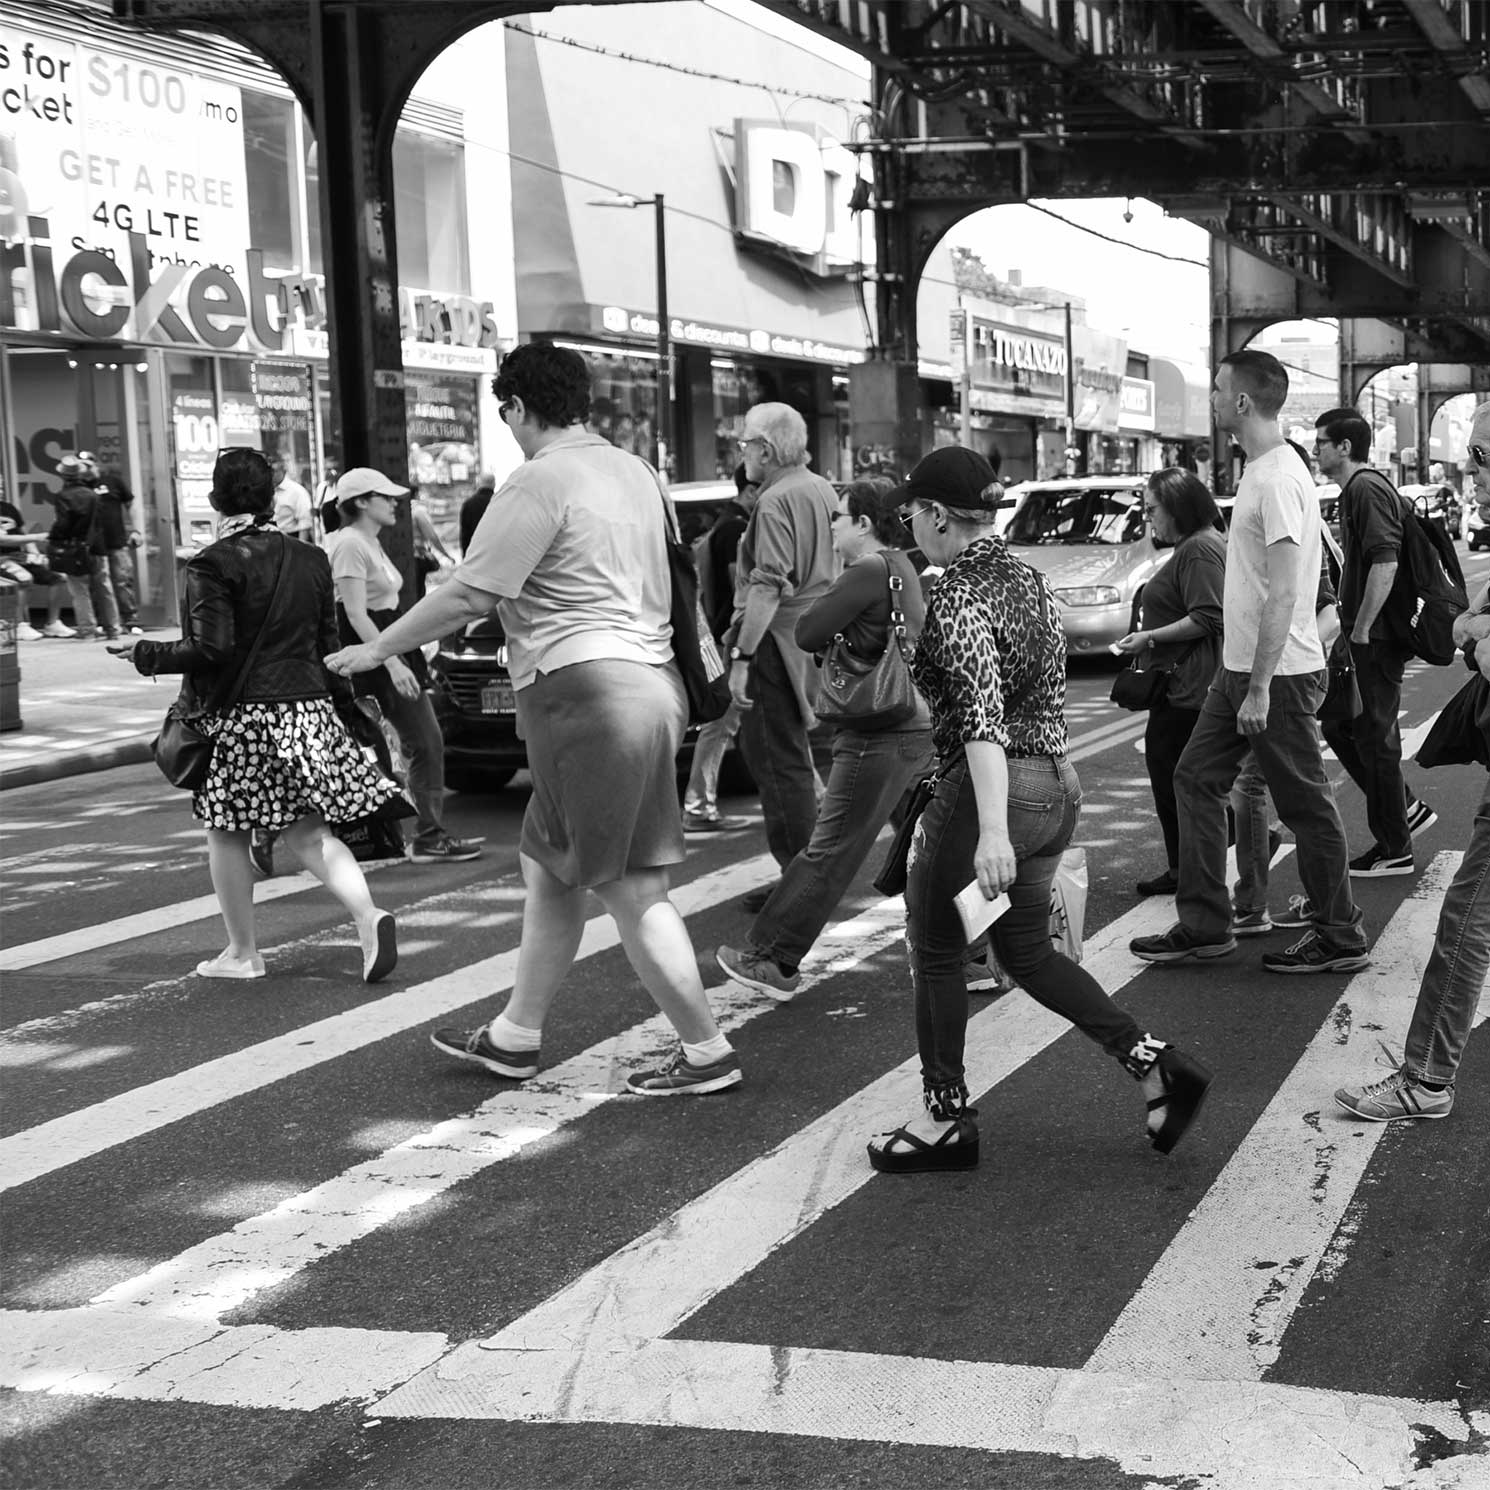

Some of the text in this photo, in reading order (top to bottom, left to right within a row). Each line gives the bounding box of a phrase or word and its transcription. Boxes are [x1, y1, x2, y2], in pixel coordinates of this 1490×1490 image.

[22, 42, 71, 83] for
[88, 55, 186, 114] $100
[59, 149, 234, 208] GET A FREE
[92, 201, 200, 242] 4G LTE
[414, 295, 498, 349] KIDS
[993, 329, 1068, 376] TUCANAZO
